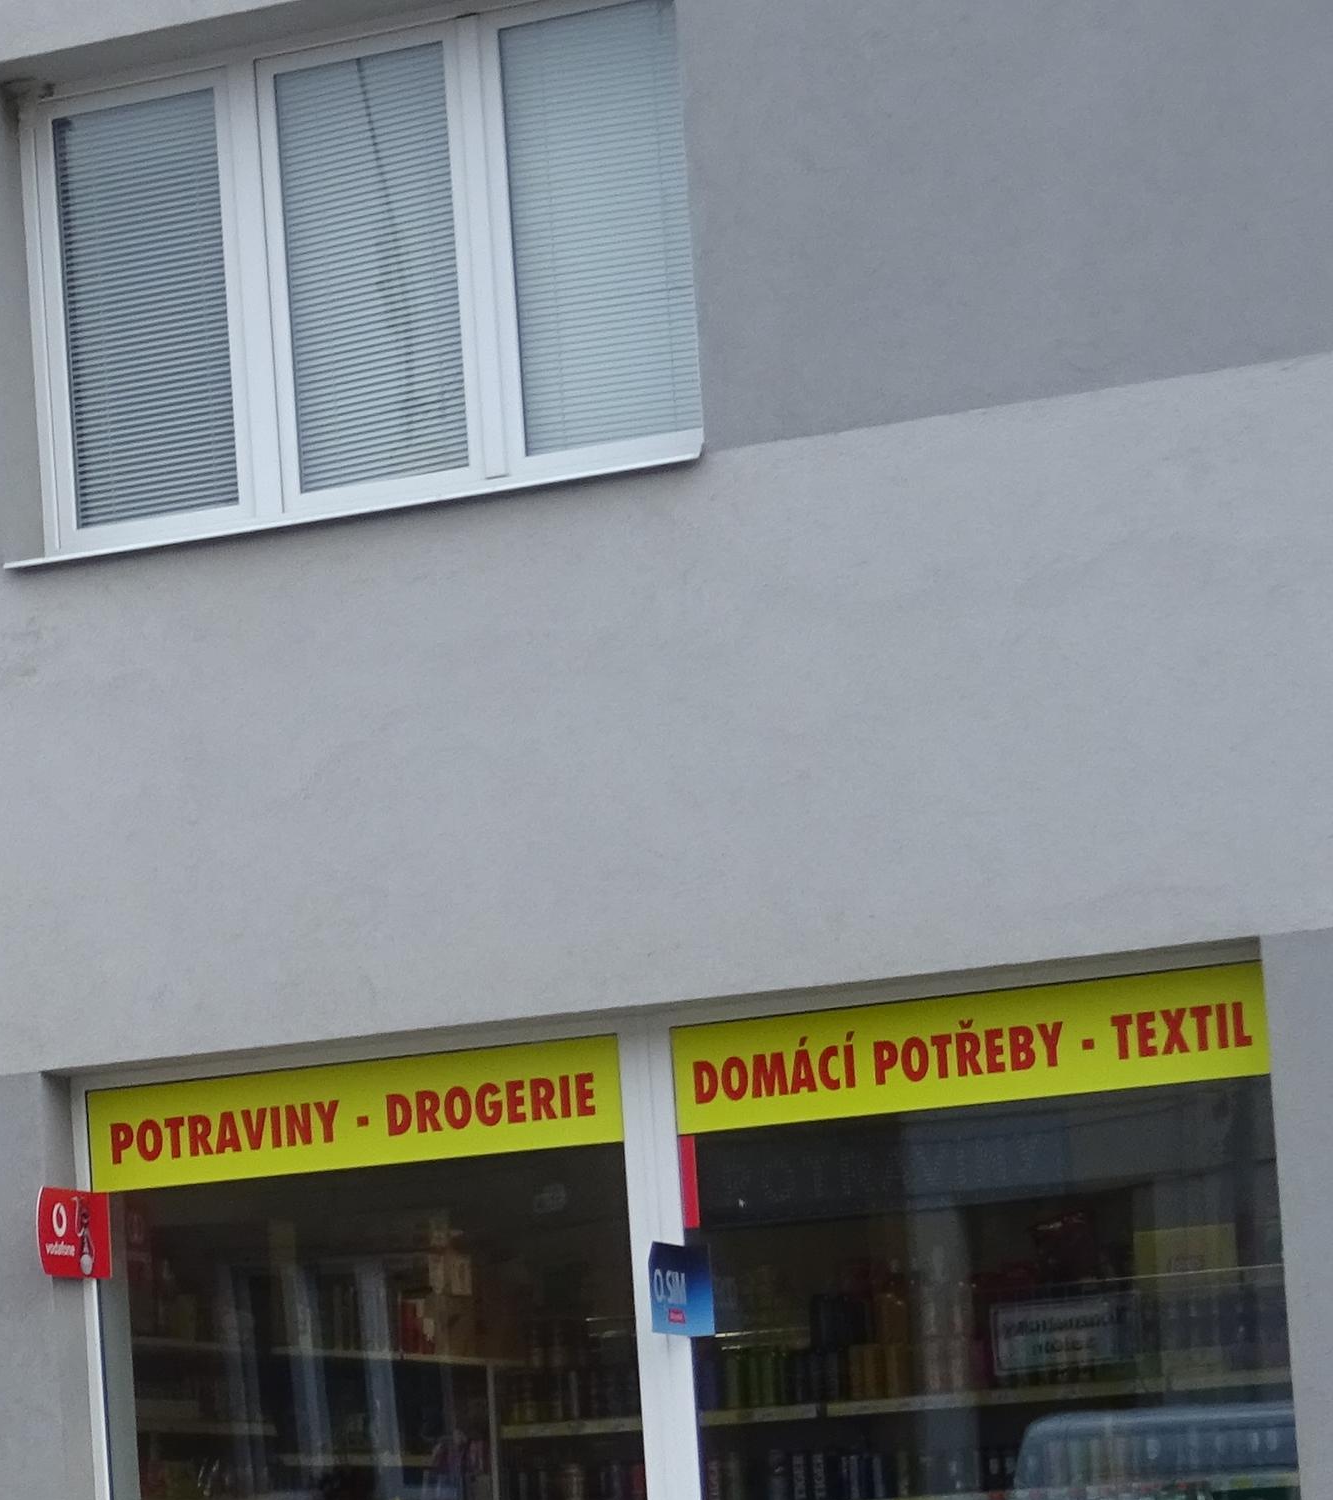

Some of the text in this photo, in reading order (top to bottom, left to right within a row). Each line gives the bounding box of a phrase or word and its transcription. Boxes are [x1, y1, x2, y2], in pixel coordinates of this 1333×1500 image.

[692, 1030, 857, 1105] DOMÁCÍ
[873, 1018, 1064, 1088] POTŘEBY
[1110, 1001, 1253, 1060] TEXTIL
[109, 1099, 340, 1165] POTRAVINY
[386, 1071, 595, 1137] DROGERIE
